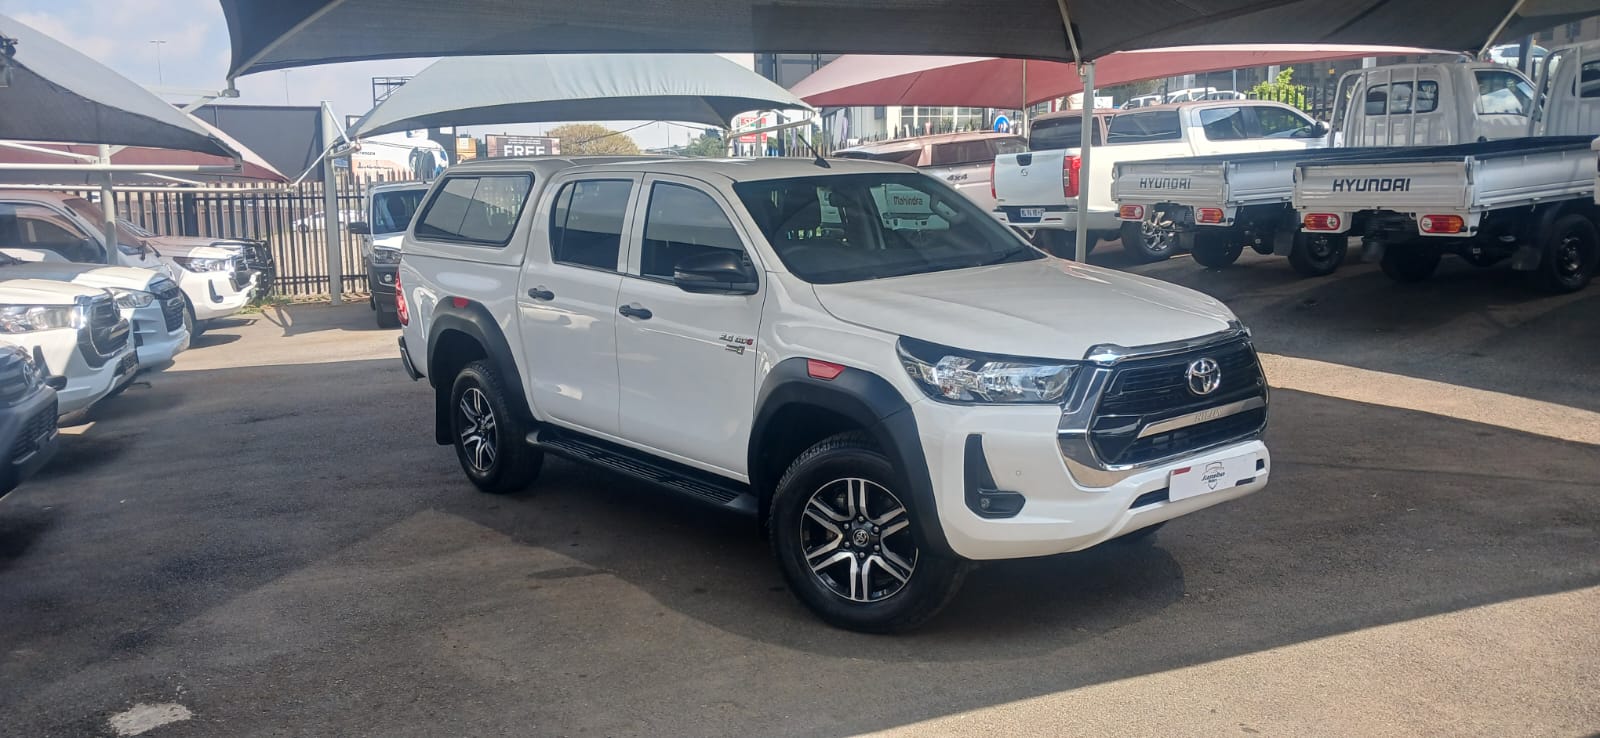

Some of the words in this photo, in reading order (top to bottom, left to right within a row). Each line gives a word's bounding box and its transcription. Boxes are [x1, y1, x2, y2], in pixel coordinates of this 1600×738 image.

[503, 144, 545, 157] FREE
[1139, 177, 1192, 189] HYUNDAI
[1332, 178, 1411, 192] HYUNDAI
